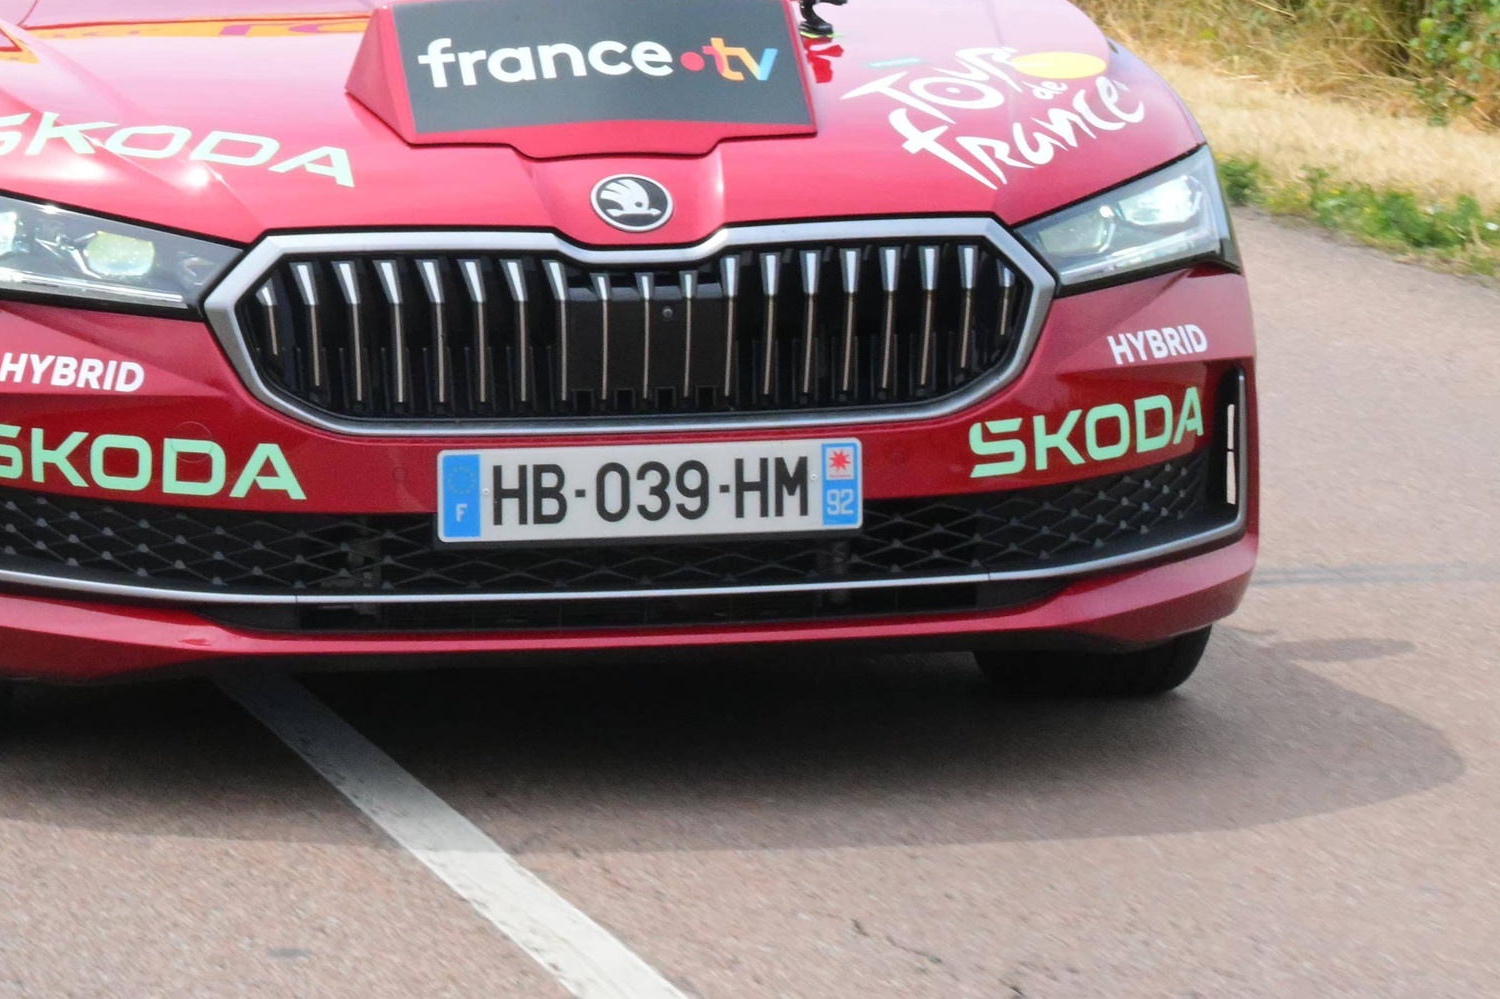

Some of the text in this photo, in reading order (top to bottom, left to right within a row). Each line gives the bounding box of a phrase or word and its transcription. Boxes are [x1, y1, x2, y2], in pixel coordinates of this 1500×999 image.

[1107, 325, 1207, 365] HYBRID
[969, 386, 1204, 478] SKODA
[456, 454, 854, 526] F HB-039-HM 92
